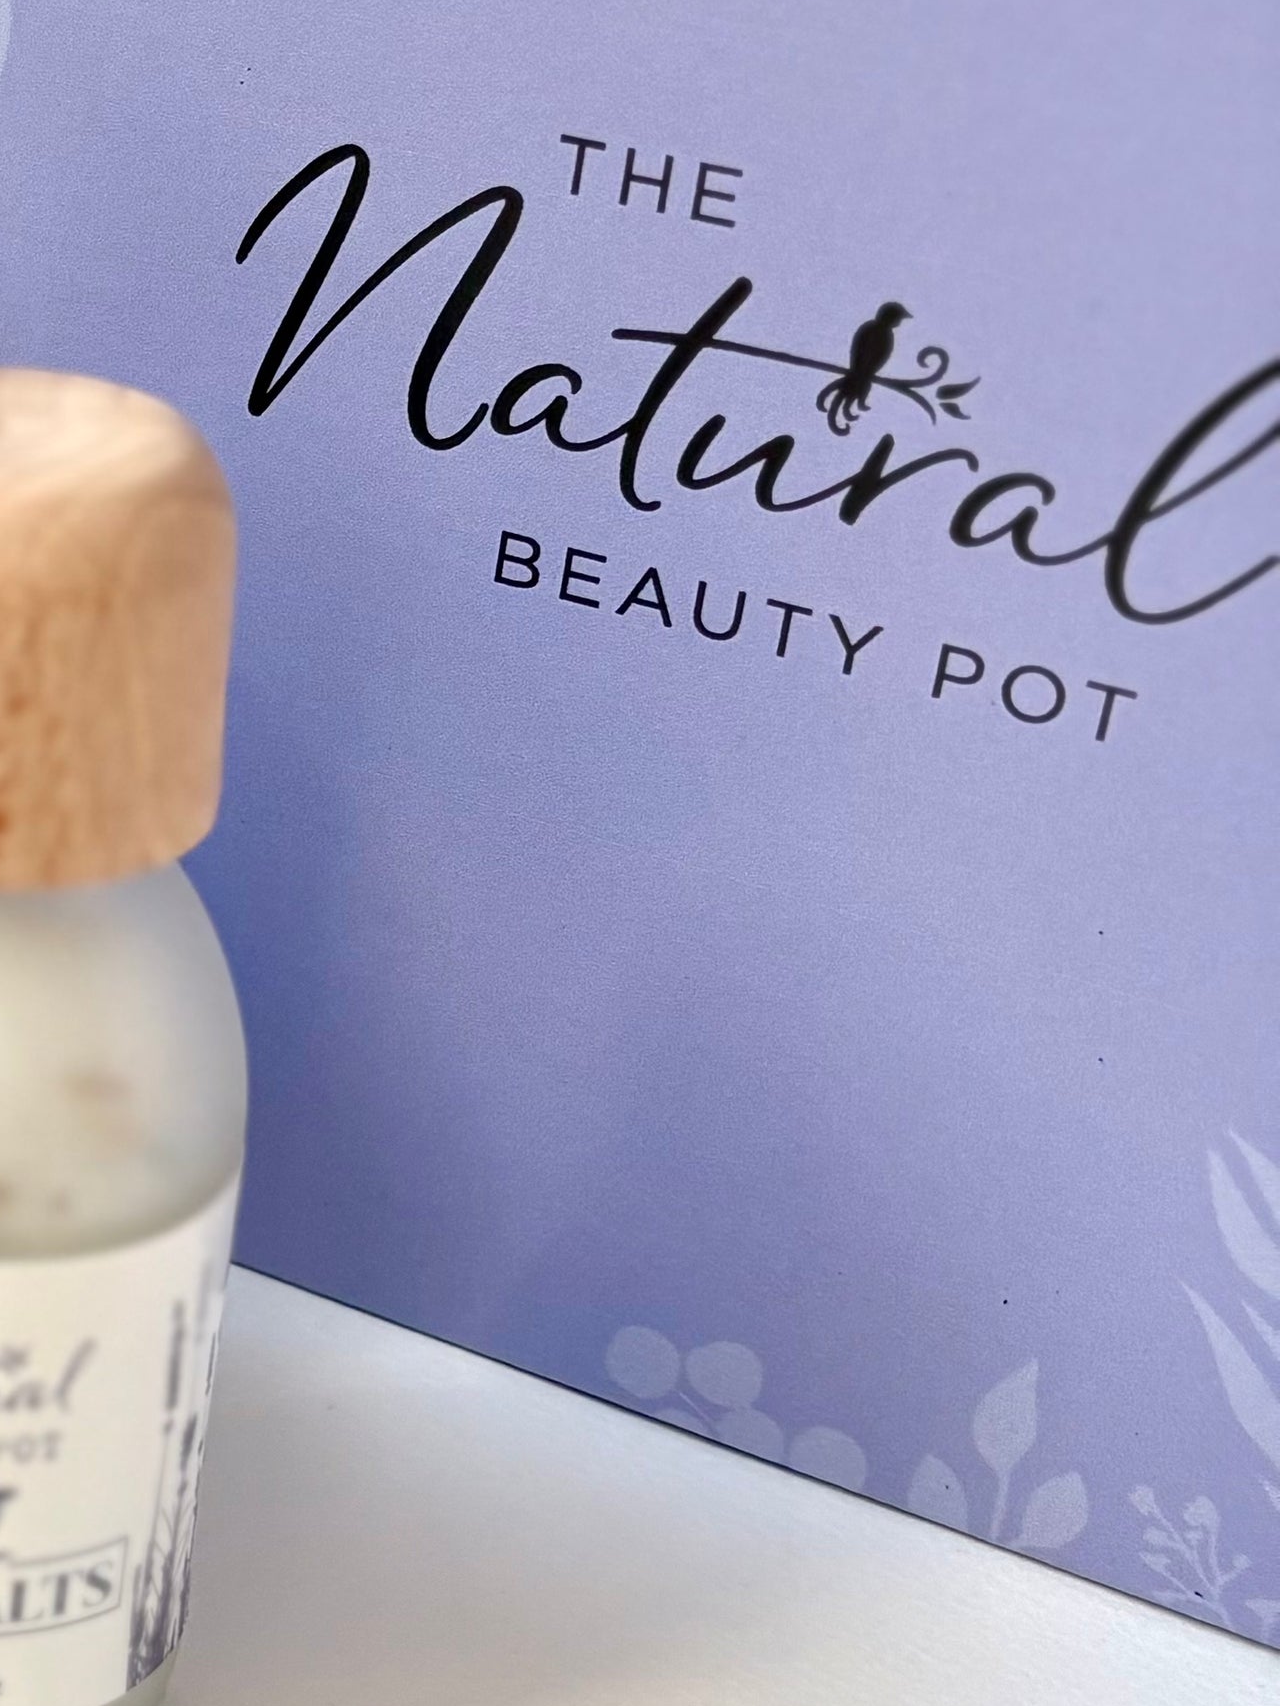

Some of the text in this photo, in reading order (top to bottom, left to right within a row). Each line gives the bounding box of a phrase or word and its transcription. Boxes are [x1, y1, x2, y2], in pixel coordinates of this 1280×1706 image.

[559, 131, 746, 230] THE
[235, 142, 1280, 627] Natural
[492, 528, 1139, 744] BEAUTY POT
